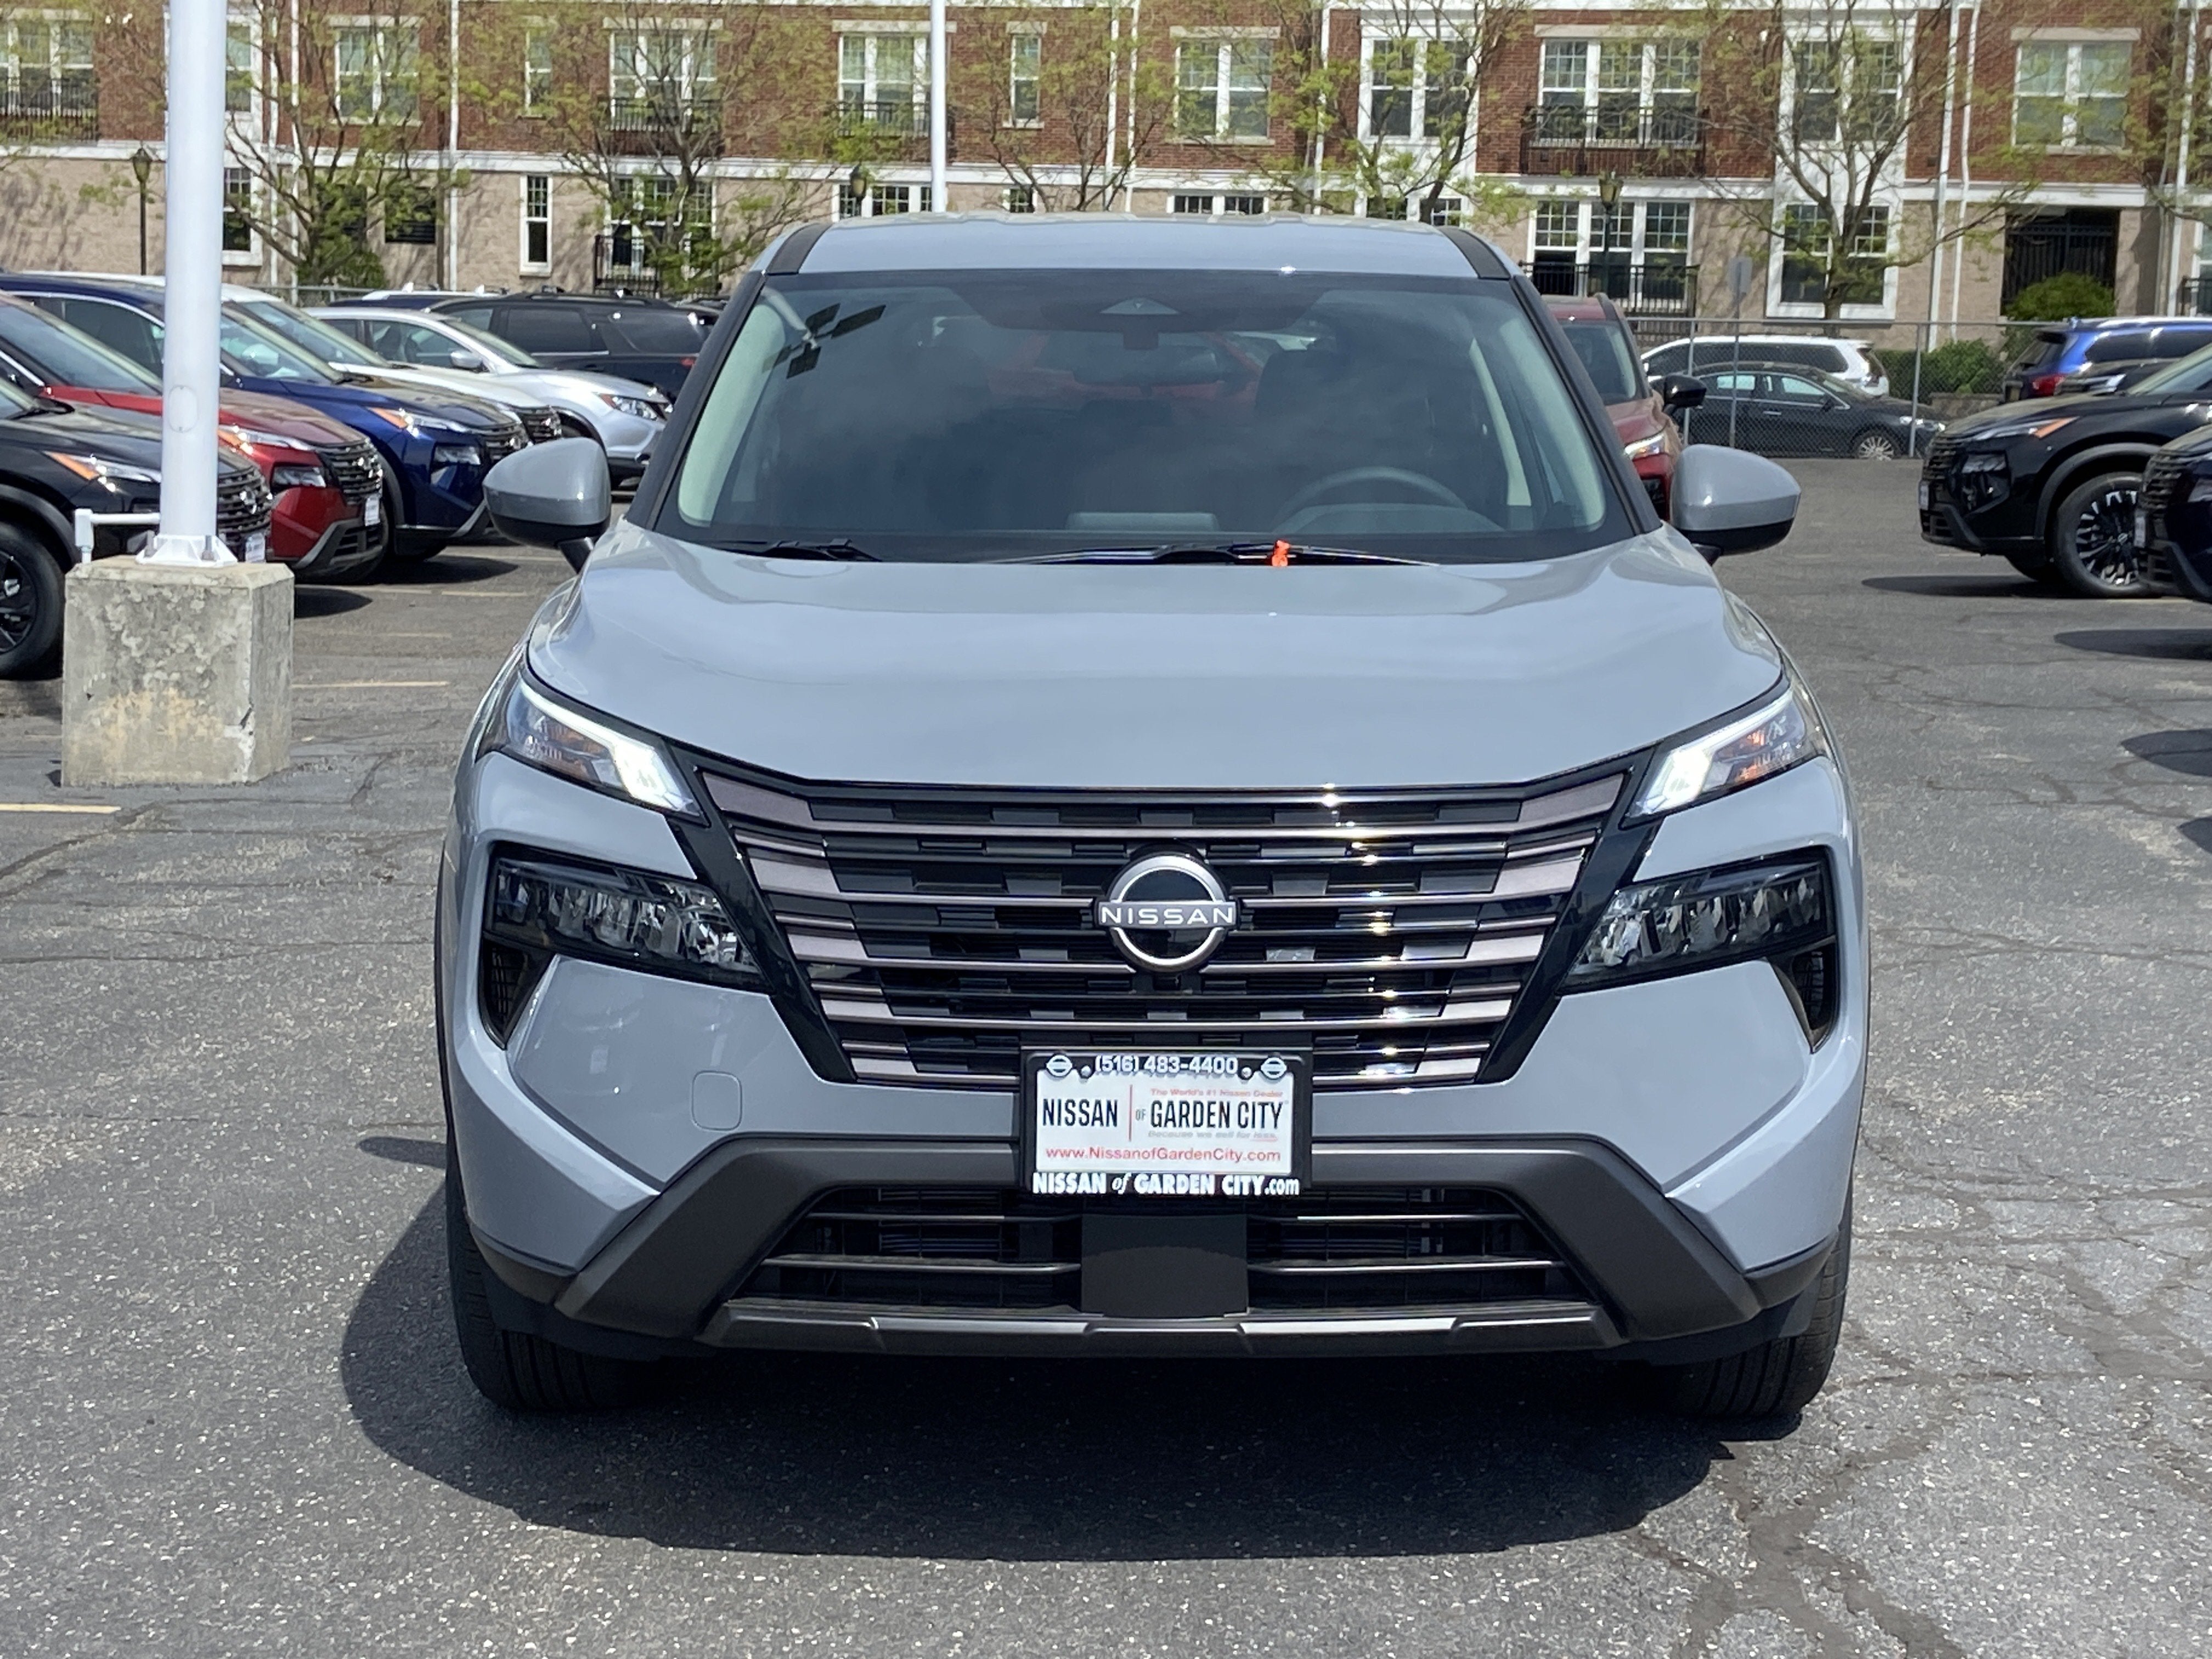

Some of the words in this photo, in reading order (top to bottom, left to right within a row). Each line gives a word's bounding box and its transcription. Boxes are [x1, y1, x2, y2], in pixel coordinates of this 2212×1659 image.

[1101, 906, 1232, 924] NISSAN
[1095, 1055, 1139, 1073] (516)
[1144, 1056, 1238, 1074] 483-4400
[1043, 1099, 1118, 1127] NISSAN
[1135, 1108, 1147, 1121] OF
[1150, 1100, 1231, 1128] GARDEN
[1238, 1101, 1283, 1130] CITY
[1046, 1147, 1281, 1163] www.NissanofGardenCity.com
[1032, 1172, 1107, 1194] NISSAN
[1111, 1172, 1132, 1194] of
[1134, 1173, 1215, 1195] GARDEN
[1222, 1175, 1300, 1195] CITY.com
